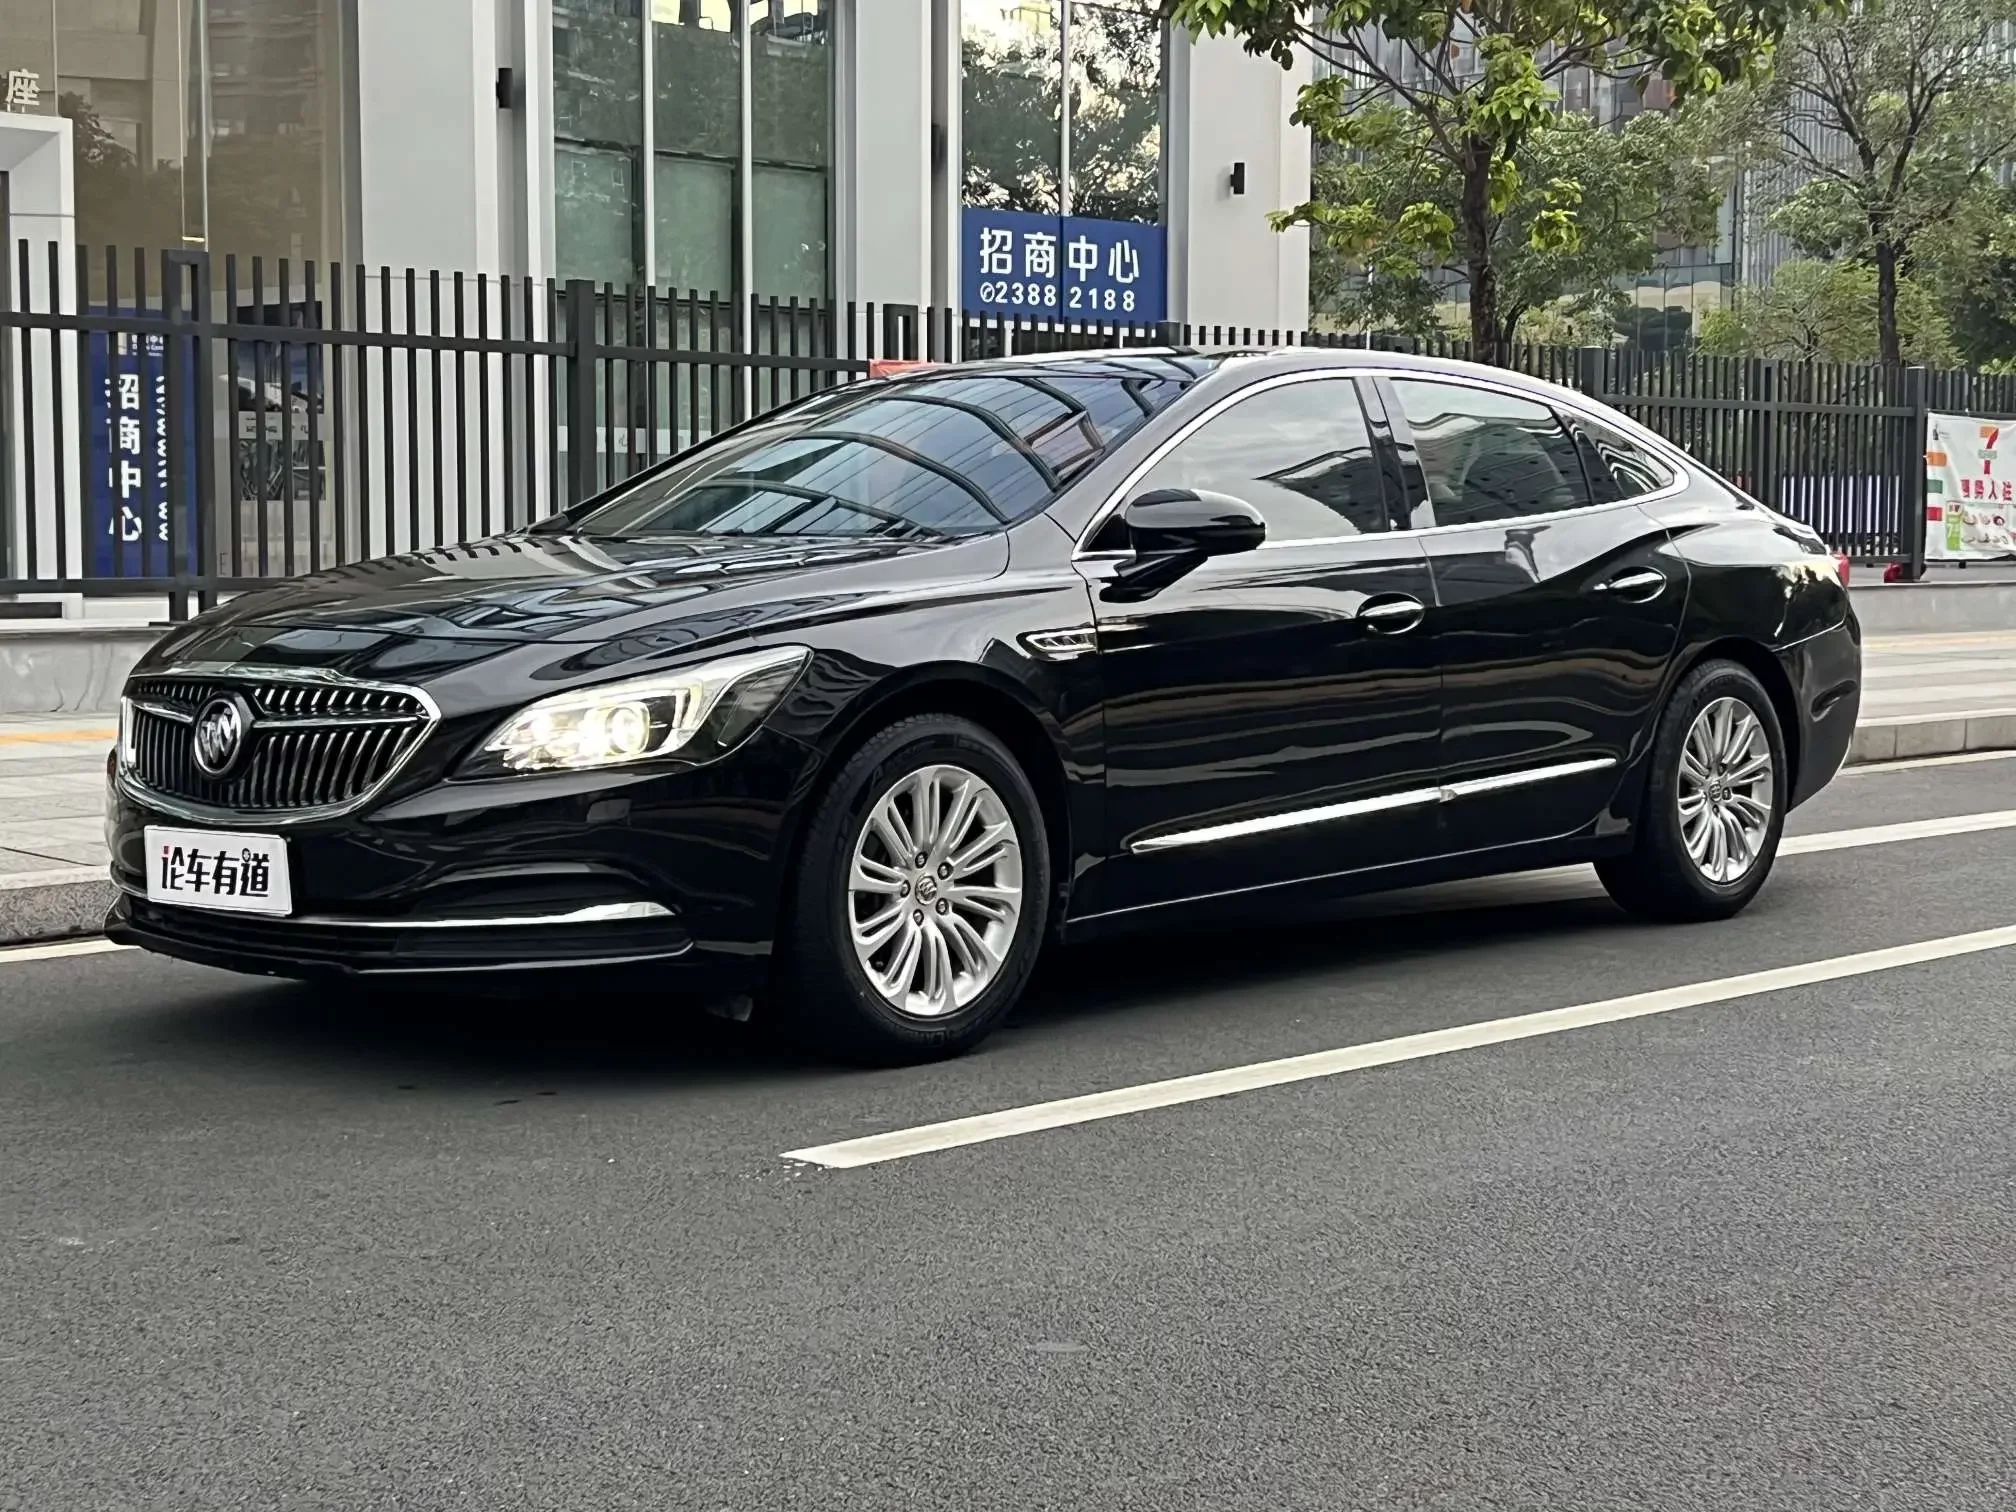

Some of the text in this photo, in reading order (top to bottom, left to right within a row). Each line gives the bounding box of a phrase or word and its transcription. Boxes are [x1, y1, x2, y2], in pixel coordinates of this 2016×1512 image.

[5, 68, 40, 105] 座
[979, 227, 1140, 284] 招商中心
[995, 281, 1136, 312] 2388 2188
